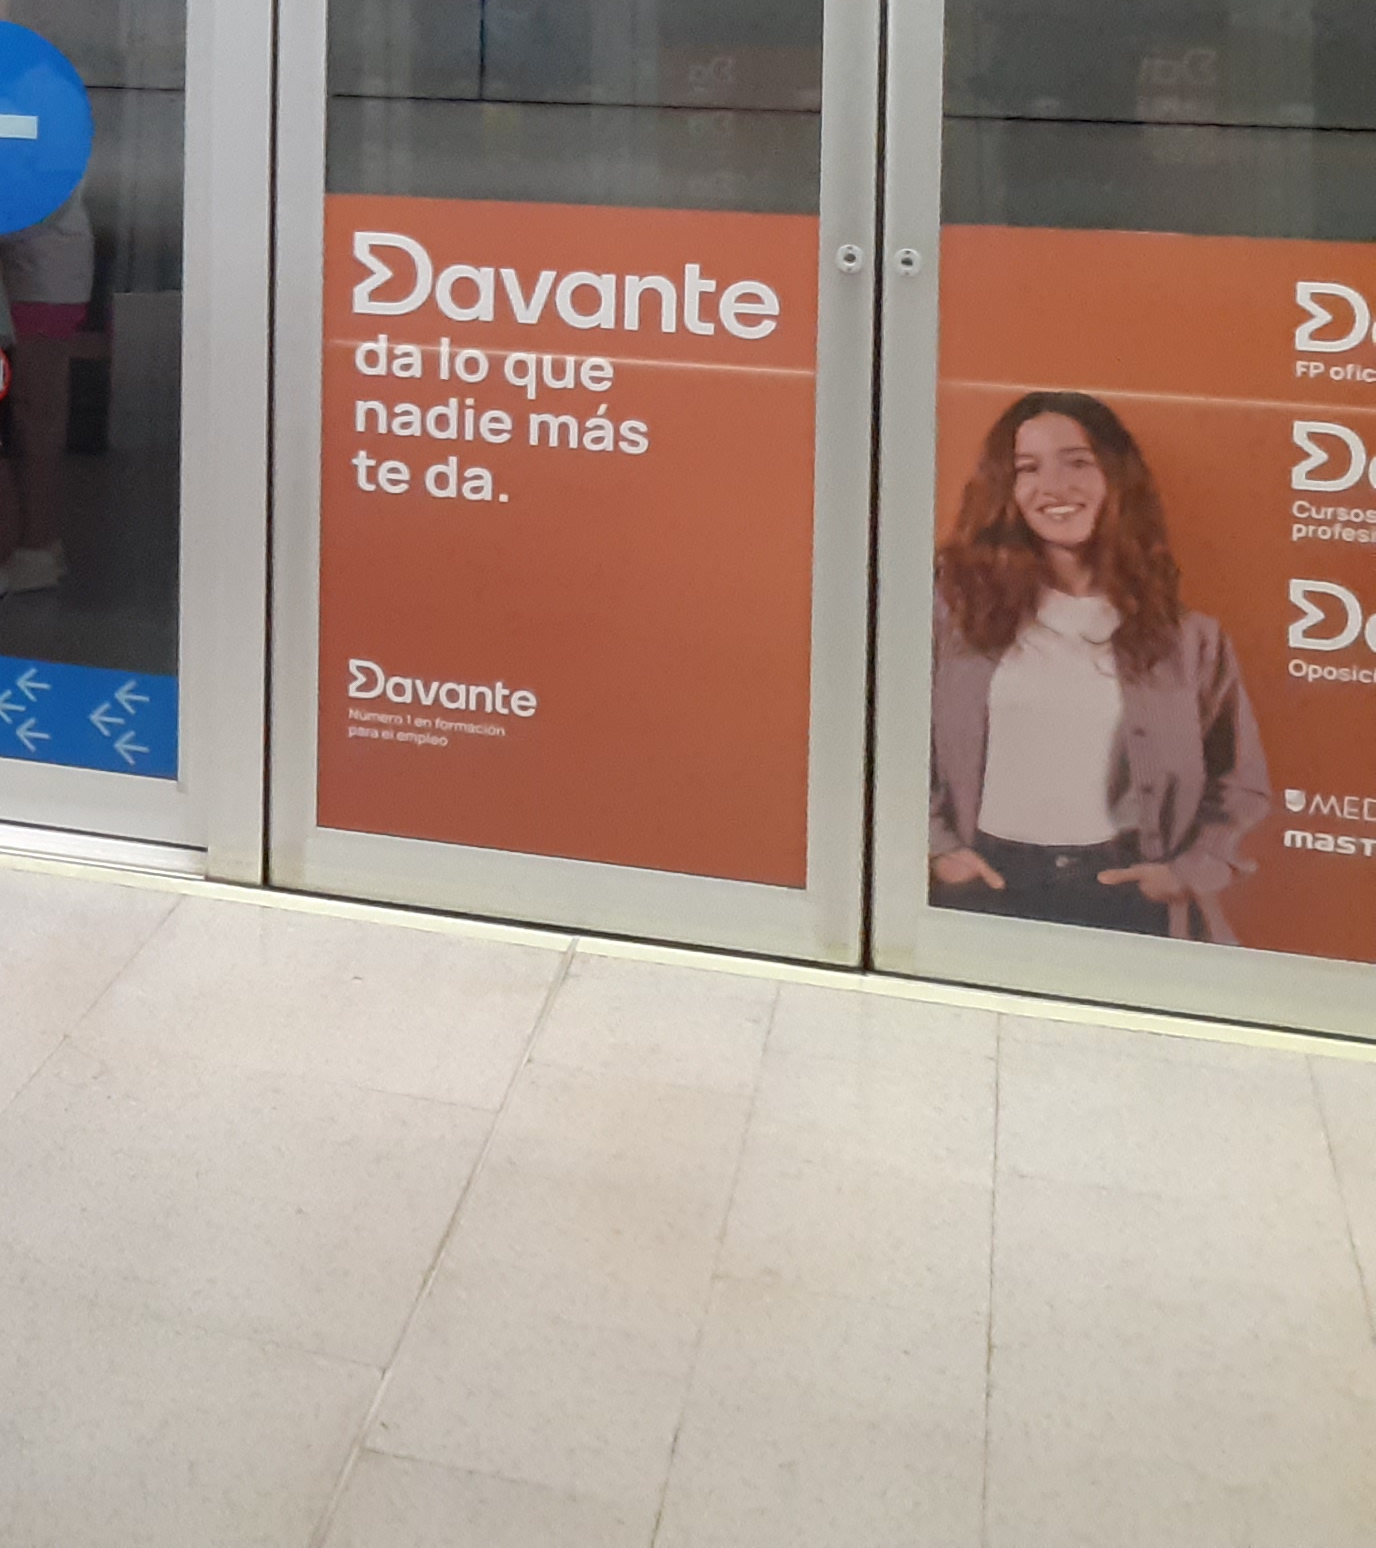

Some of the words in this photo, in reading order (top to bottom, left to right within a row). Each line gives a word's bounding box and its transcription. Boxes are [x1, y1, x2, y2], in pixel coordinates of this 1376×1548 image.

[352, 230, 781, 340] Davante
[354, 334, 423, 379] da
[439, 336, 489, 383] lo
[502, 350, 615, 399] que
[1295, 360, 1326, 378] FP
[354, 396, 513, 445] nadie
[528, 403, 650, 455] más
[352, 449, 411, 494] te
[424, 456, 510, 503] da.
[348, 658, 538, 718] Davante
[348, 725, 380, 739] para
